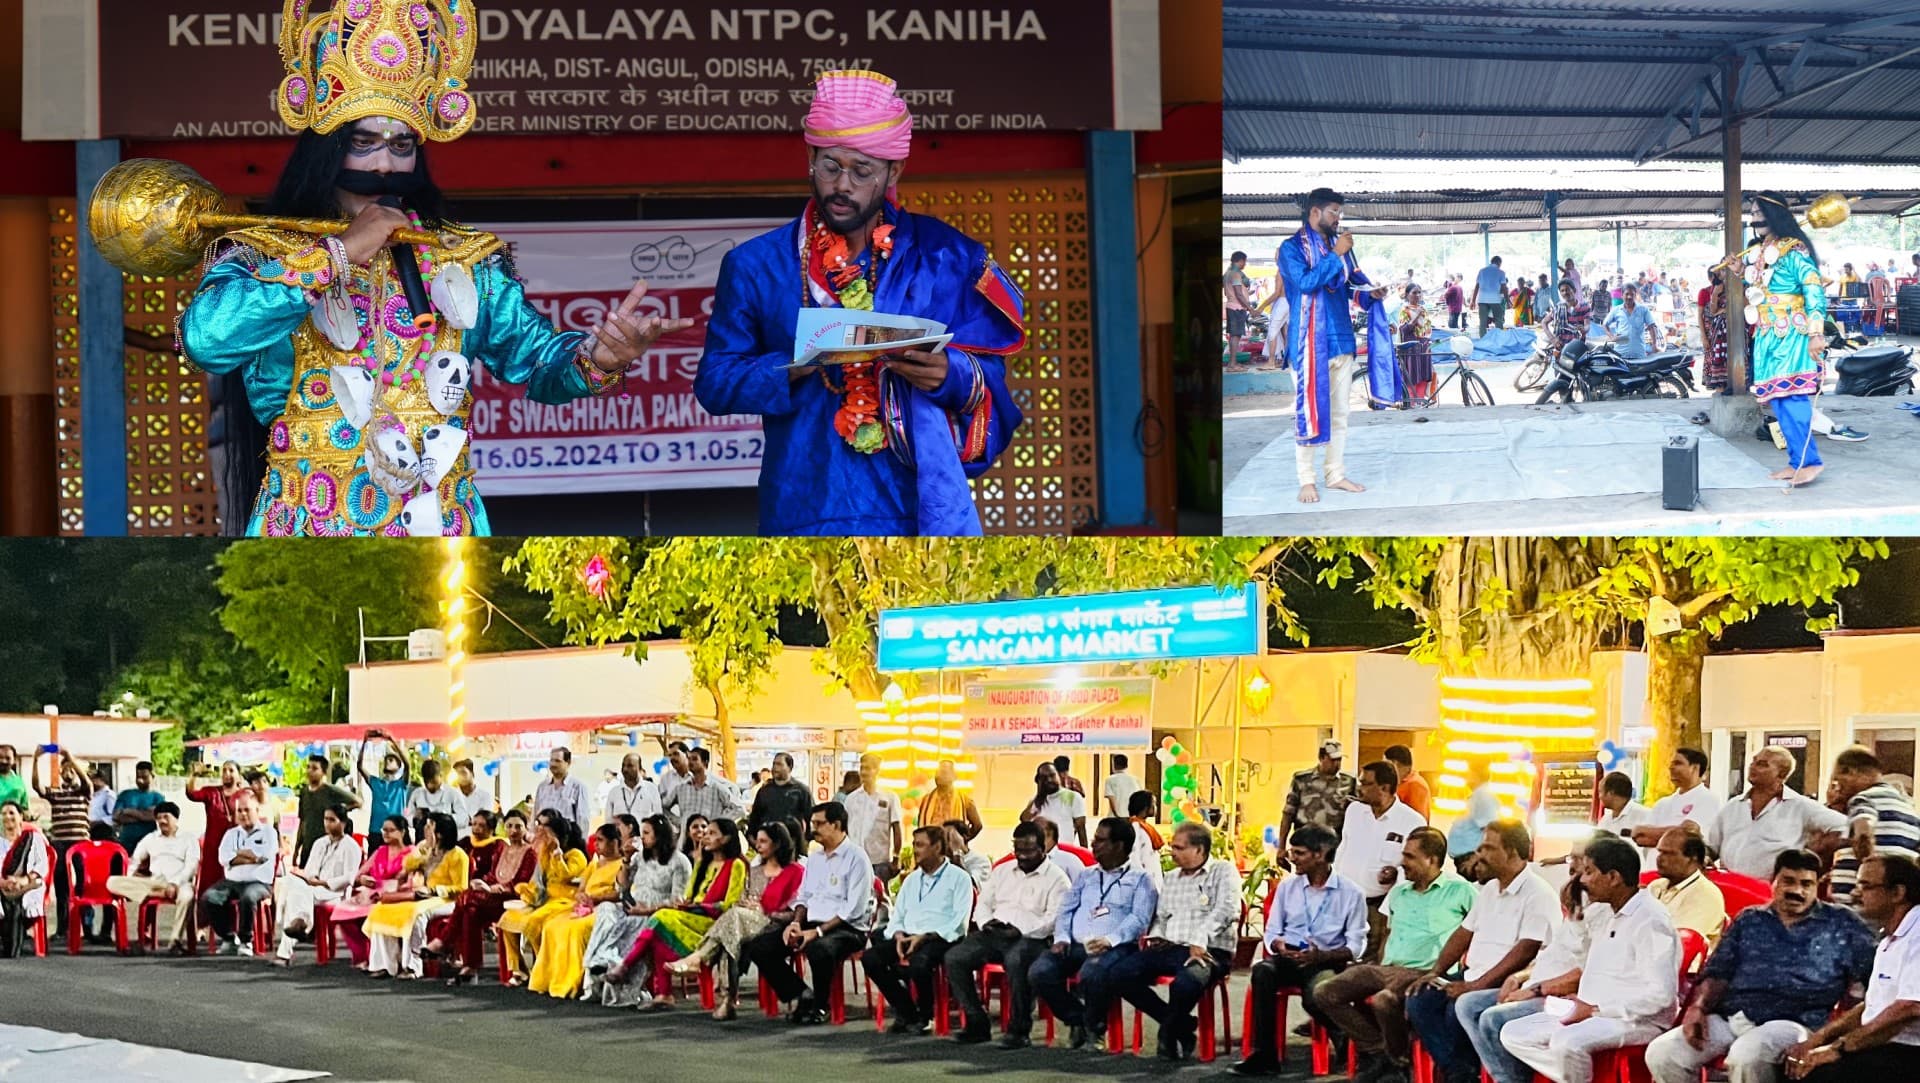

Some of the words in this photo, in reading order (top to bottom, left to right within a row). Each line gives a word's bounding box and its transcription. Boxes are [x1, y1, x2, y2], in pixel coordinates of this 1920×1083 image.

[479, 9, 696, 41] DYALAYA
[710, 8, 849, 46] NTPC,
[866, 9, 1047, 41] KANIHA
[466, 58, 548, 80] HIKHA,
[554, 58, 611, 79] DIST-
[615, 58, 699, 81] ANGUL,
[705, 58, 795, 80] ODISHA,
[470, 89, 517, 108] ारत
[526, 89, 610, 107] सरकार
[620, 83, 647, 107] के
[656, 83, 731, 107] अधीन
[739, 88, 781, 107] एक
[172, 122, 202, 137] AN
[522, 114, 623, 131] MINISTRY
[629, 114, 659, 130] OF
[666, 114, 793, 132] EDUCATION,
[955, 114, 983, 130] OF
[990, 114, 1047, 129] INDIA
[473, 400, 502, 435] OF
[508, 393, 646, 434] SWACHHATA
[472, 442, 618, 470] 16.05.2024
[624, 441, 660, 463] TO
[667, 437, 762, 463] 31.05.2
[946, 633, 1054, 663] SANGAM
[1060, 626, 1175, 656] MARKET
[988, 690, 1049, 705] INAUGURATION
[1091, 687, 1120, 703] PLAZA
[968, 717, 988, 730] SHRI
[1060, 732, 1081, 742] 2024
